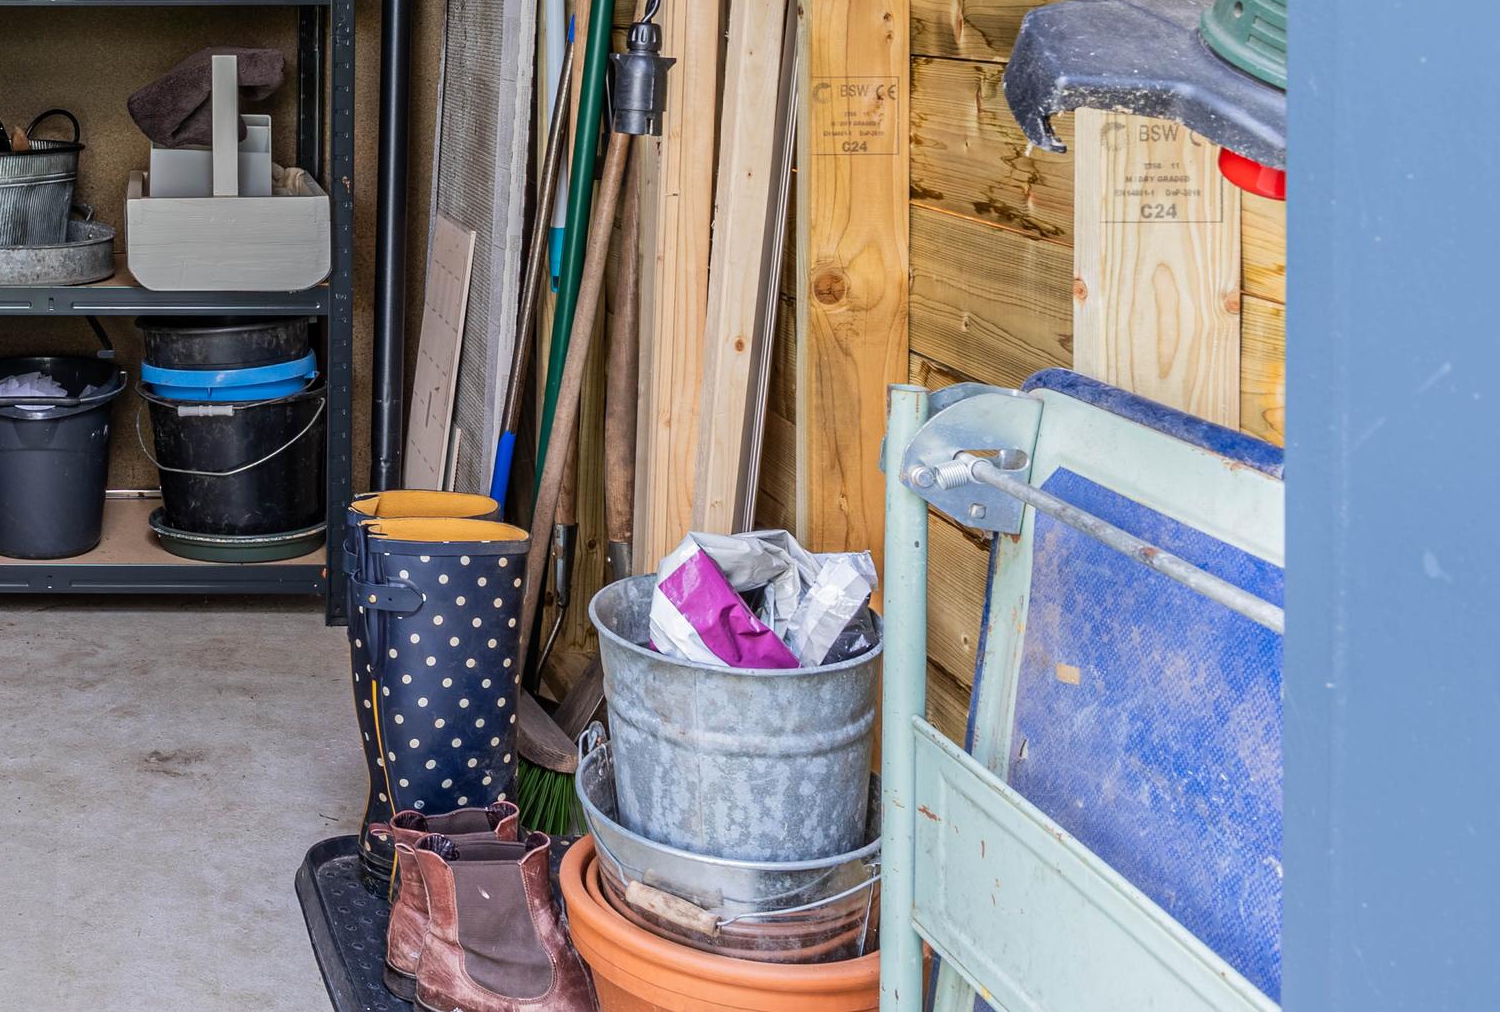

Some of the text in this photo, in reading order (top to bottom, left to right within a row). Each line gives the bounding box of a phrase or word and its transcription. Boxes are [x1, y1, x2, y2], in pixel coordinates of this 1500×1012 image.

[840, 84, 869, 97] BSW
[1139, 124, 1179, 143] BSW
[842, 140, 868, 153] C24
[1140, 203, 1178, 219] C24
